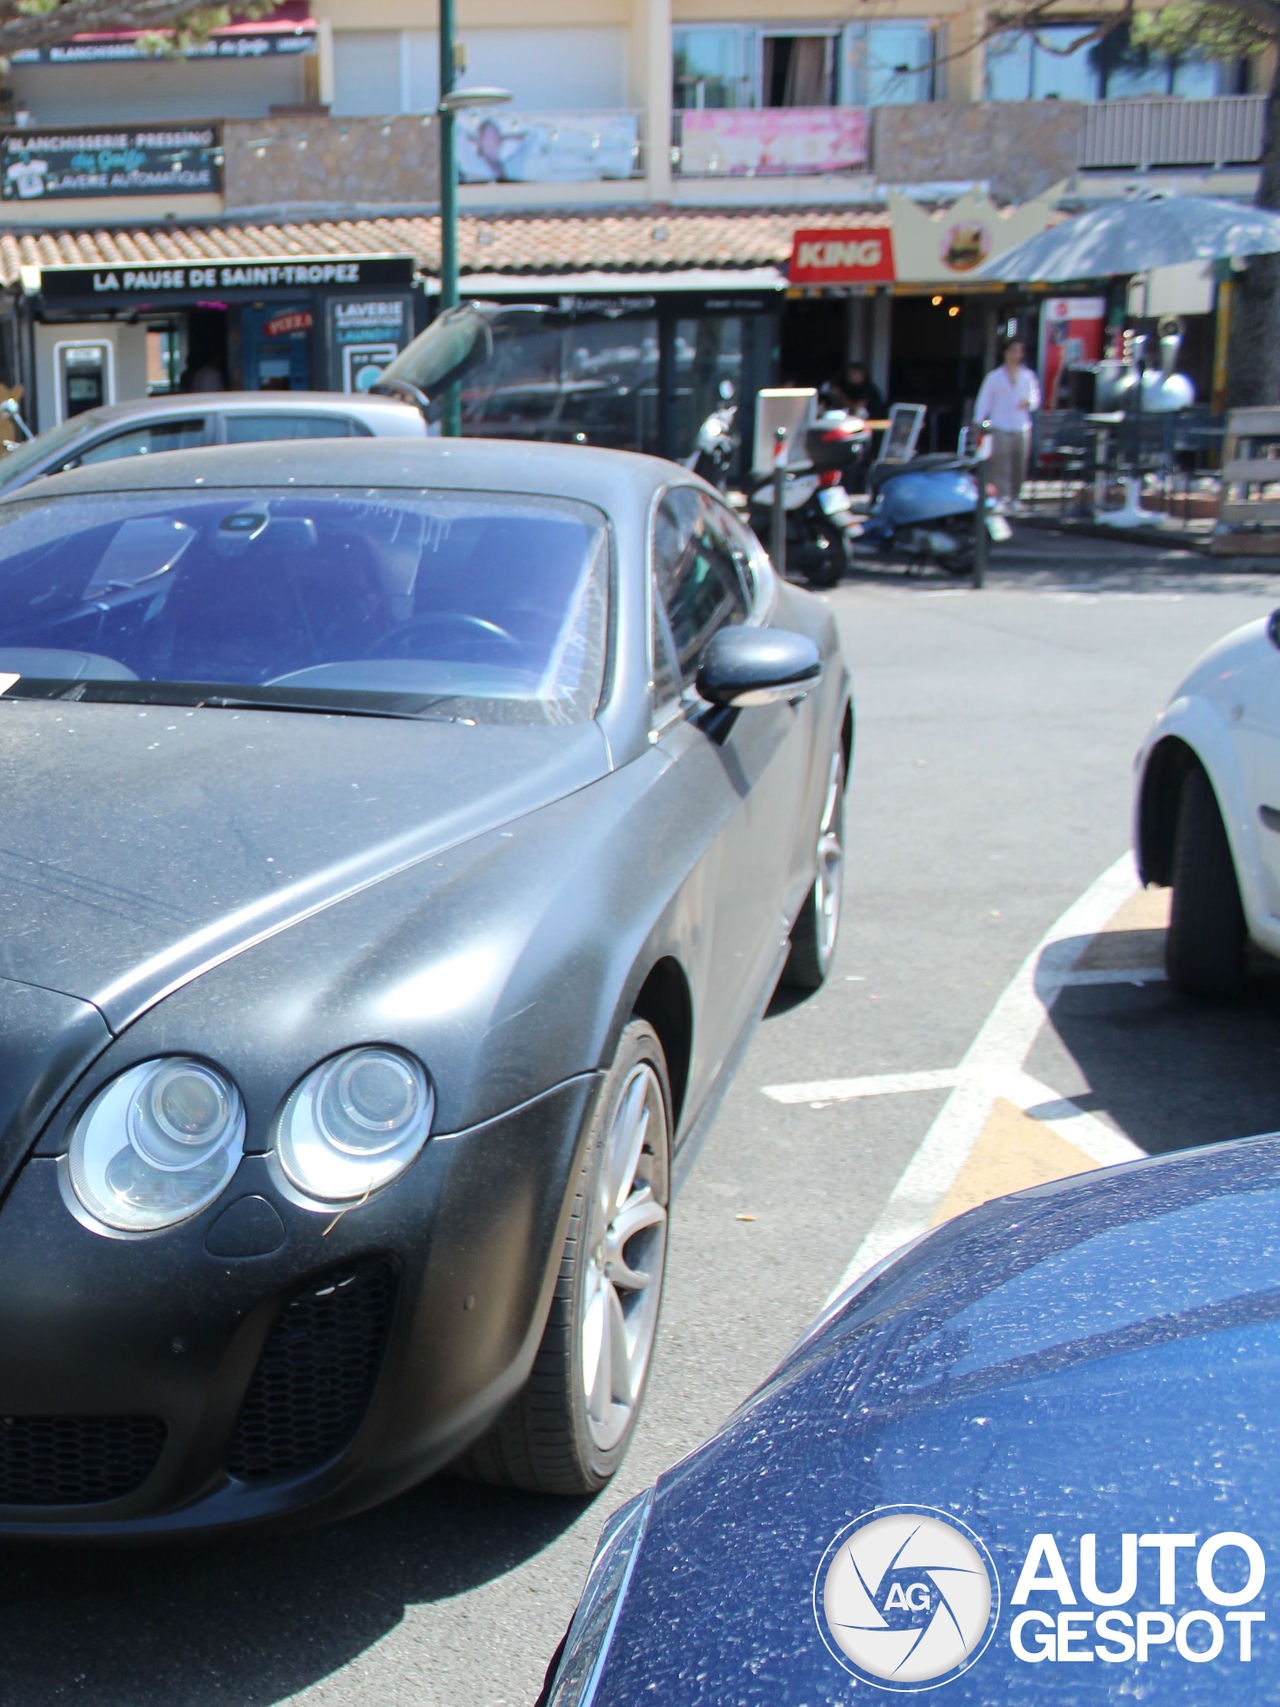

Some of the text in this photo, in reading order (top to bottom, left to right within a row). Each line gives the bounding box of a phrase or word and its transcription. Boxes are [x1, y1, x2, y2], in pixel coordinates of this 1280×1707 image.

[7, 130, 213, 154] BLANCHISSERIE PRESSING
[110, 169, 211, 188] AUTOMATIQUE
[797, 240, 881, 268] KING
[93, 264, 360, 291] LA PAUSE DE SAINT-TROPEZ
[335, 302, 403, 319] LAVERIE
